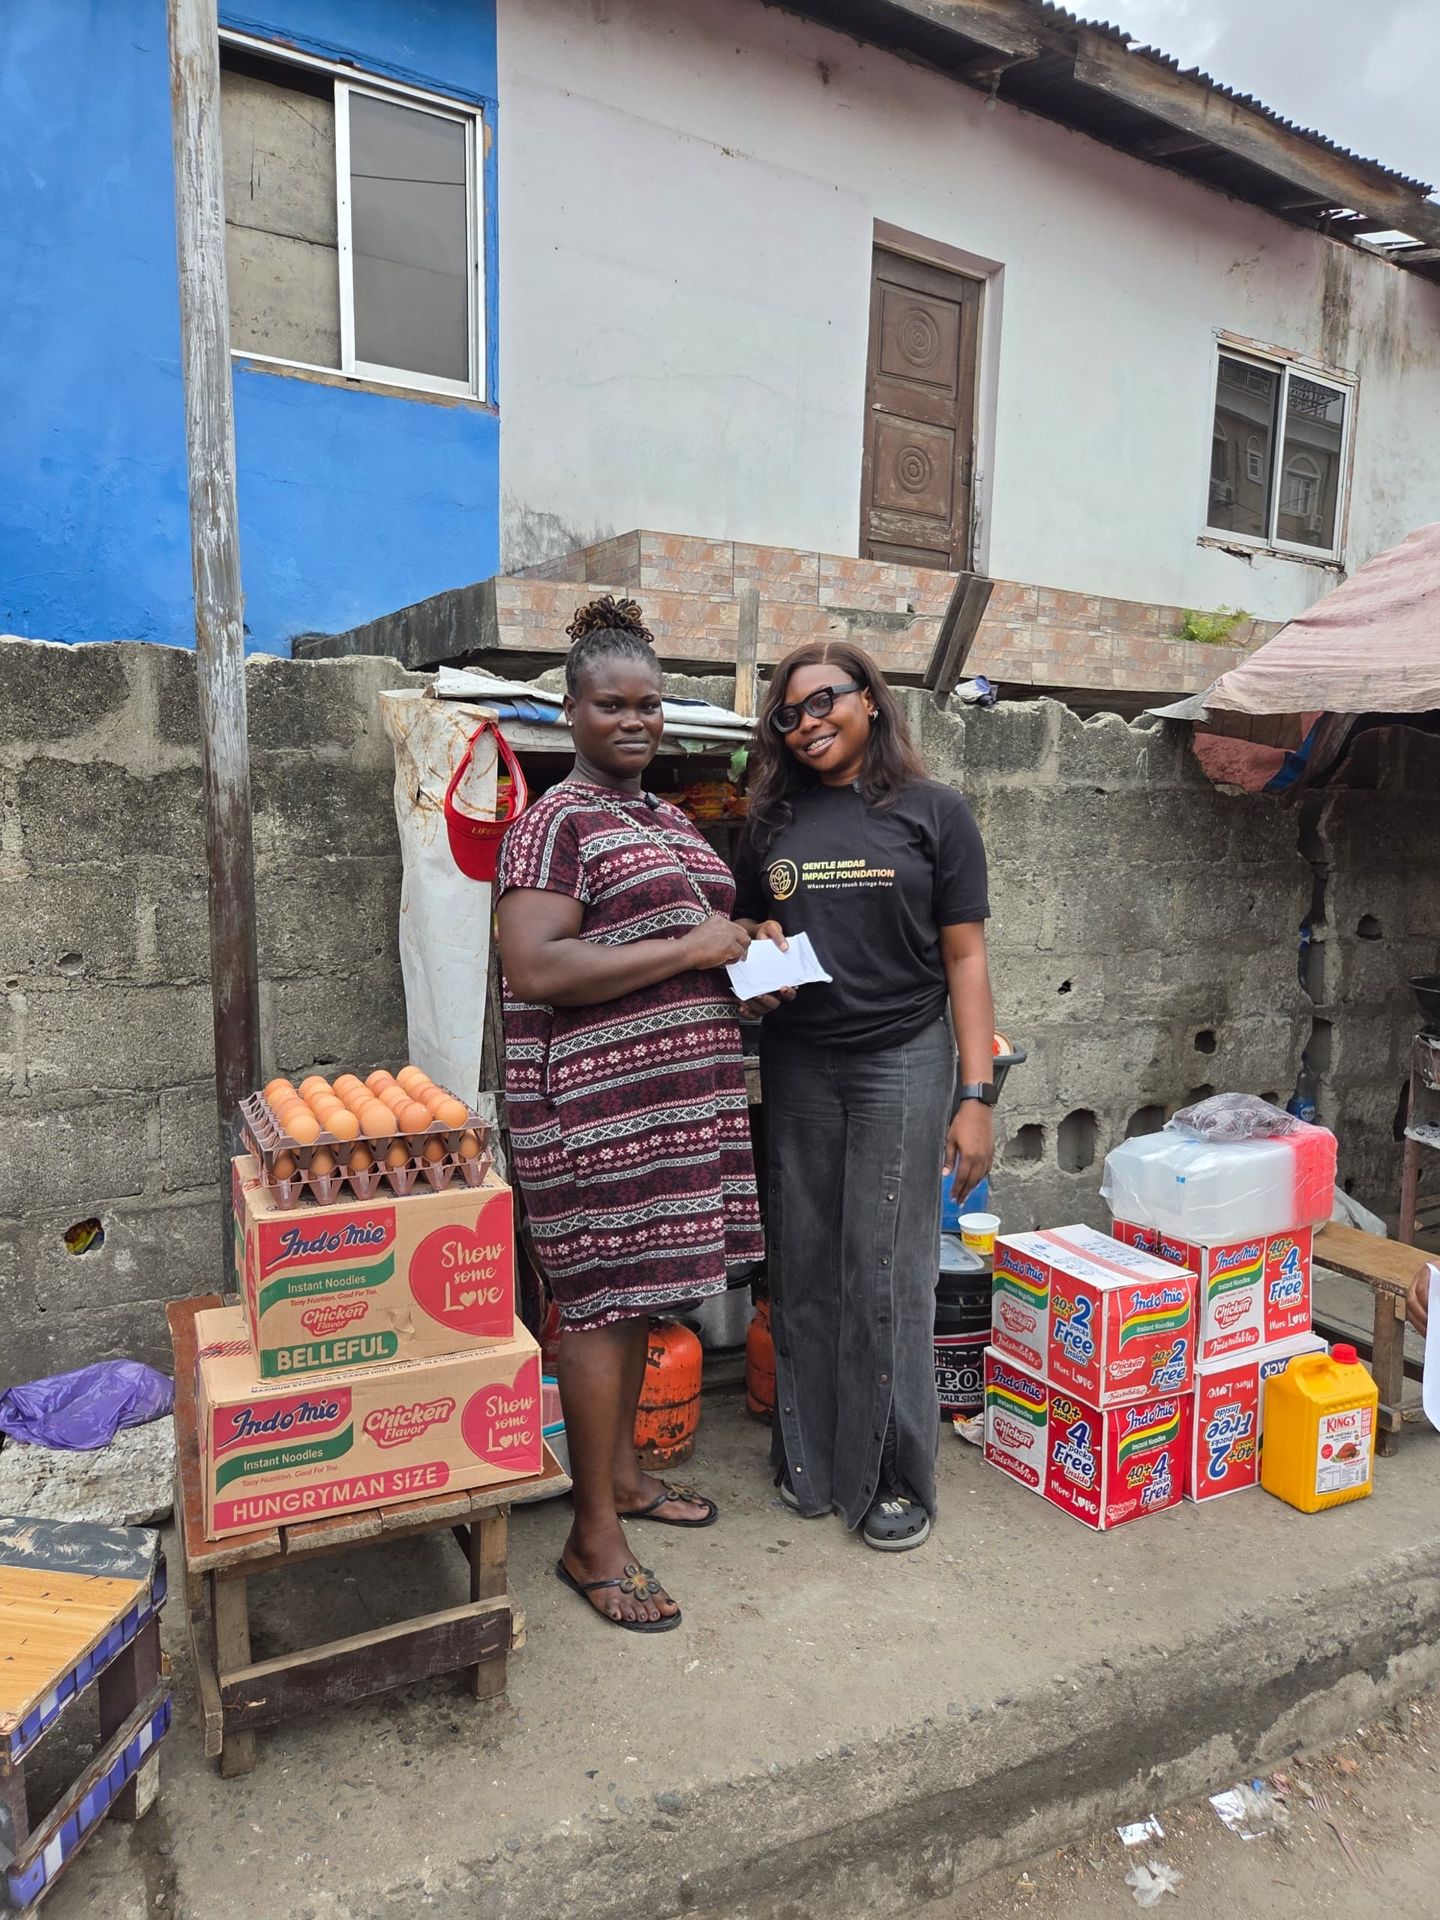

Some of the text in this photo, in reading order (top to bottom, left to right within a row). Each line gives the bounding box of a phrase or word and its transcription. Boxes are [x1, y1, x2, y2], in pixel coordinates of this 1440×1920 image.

[802, 860, 866, 870] GENTLE MIDAS
[802, 869, 895, 880] IMPACT FOUNDATION
[441, 1241, 506, 1268] Show
[1268, 1239, 1293, 1254] 40+
[1281, 1247, 1299, 1274] 4
[288, 1275, 366, 1293] Instant Noodles
[454, 1266, 496, 1284] some
[338, 1291, 354, 1299] Good
[1269, 1279, 1302, 1302] Free
[1053, 1296, 1075, 1313] 40+
[1072, 1296, 1092, 1329] 2
[1215, 1299, 1250, 1318] Chicken
[303, 1305, 364, 1325] Chicken
[317, 1320, 347, 1330] Flavor
[1070, 1323, 1089, 1337] packs
[1054, 1319, 1093, 1355] Free
[277, 1335, 389, 1371] BELLEFUL
[1169, 1340, 1186, 1363] 2
[1053, 1360, 1070, 1376] More
[1151, 1367, 1186, 1385] Free
[1264, 1360, 1287, 1376] ACK
[485, 1395, 536, 1418] Show
[1052, 1397, 1081, 1419] 40+
[366, 1404, 449, 1431] Chicken
[495, 1415, 528, 1430] some
[1207, 1413, 1252, 1439] Free
[384, 1424, 425, 1440] Flavor
[994, 1418, 1031, 1447] Chicken
[1067, 1422, 1089, 1449] 4
[1210, 1435, 1234, 1447] packs
[243, 1449, 323, 1471] Instant Noodles
[1054, 1442, 1093, 1476] Free
[1069, 1445, 1092, 1461] packs
[1209, 1444, 1231, 1478] 2
[295, 1468, 313, 1478] Good
[1127, 1464, 1152, 1480] 40+
[1152, 1452, 1168, 1478] 4
[1066, 1467, 1089, 1485] Inside
[233, 1467, 437, 1522] HUNGRYMAN SIZE
[1051, 1480, 1070, 1498] More
[1141, 1483, 1171, 1505] Free
